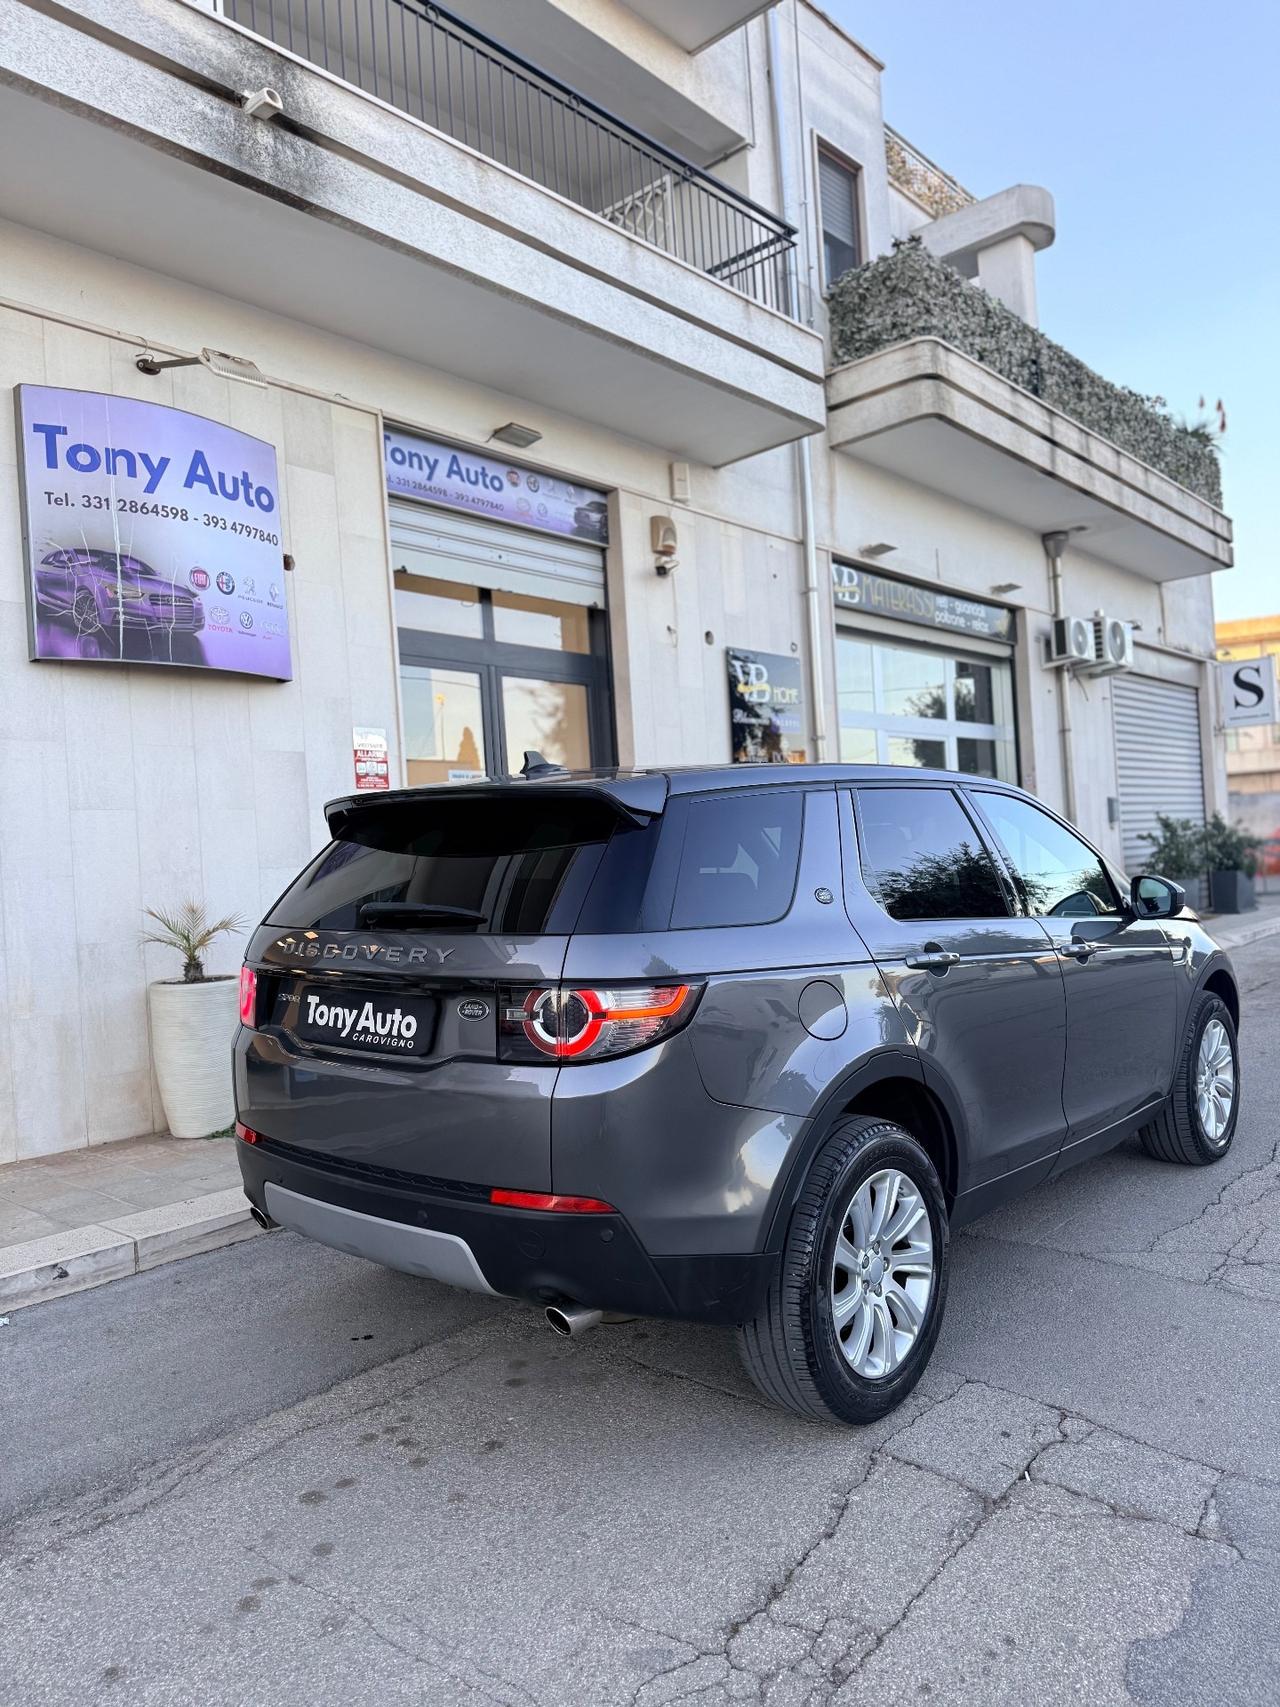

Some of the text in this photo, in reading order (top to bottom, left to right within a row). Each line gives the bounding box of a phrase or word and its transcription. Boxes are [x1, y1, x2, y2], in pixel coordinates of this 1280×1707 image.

[33, 423, 275, 513] Tony Auto
[446, 454, 504, 492] Auto
[44, 491, 75, 507] Tel.
[82, 495, 110, 511] 331
[118, 499, 188, 522] 2864598
[203, 513, 227, 531] 393
[230, 522, 279, 547] 4797840
[207, 624, 233, 633] TOYOTA
[1233, 665, 1264, 710] S
[352, 1033, 415, 1049] CAROVIGNO
